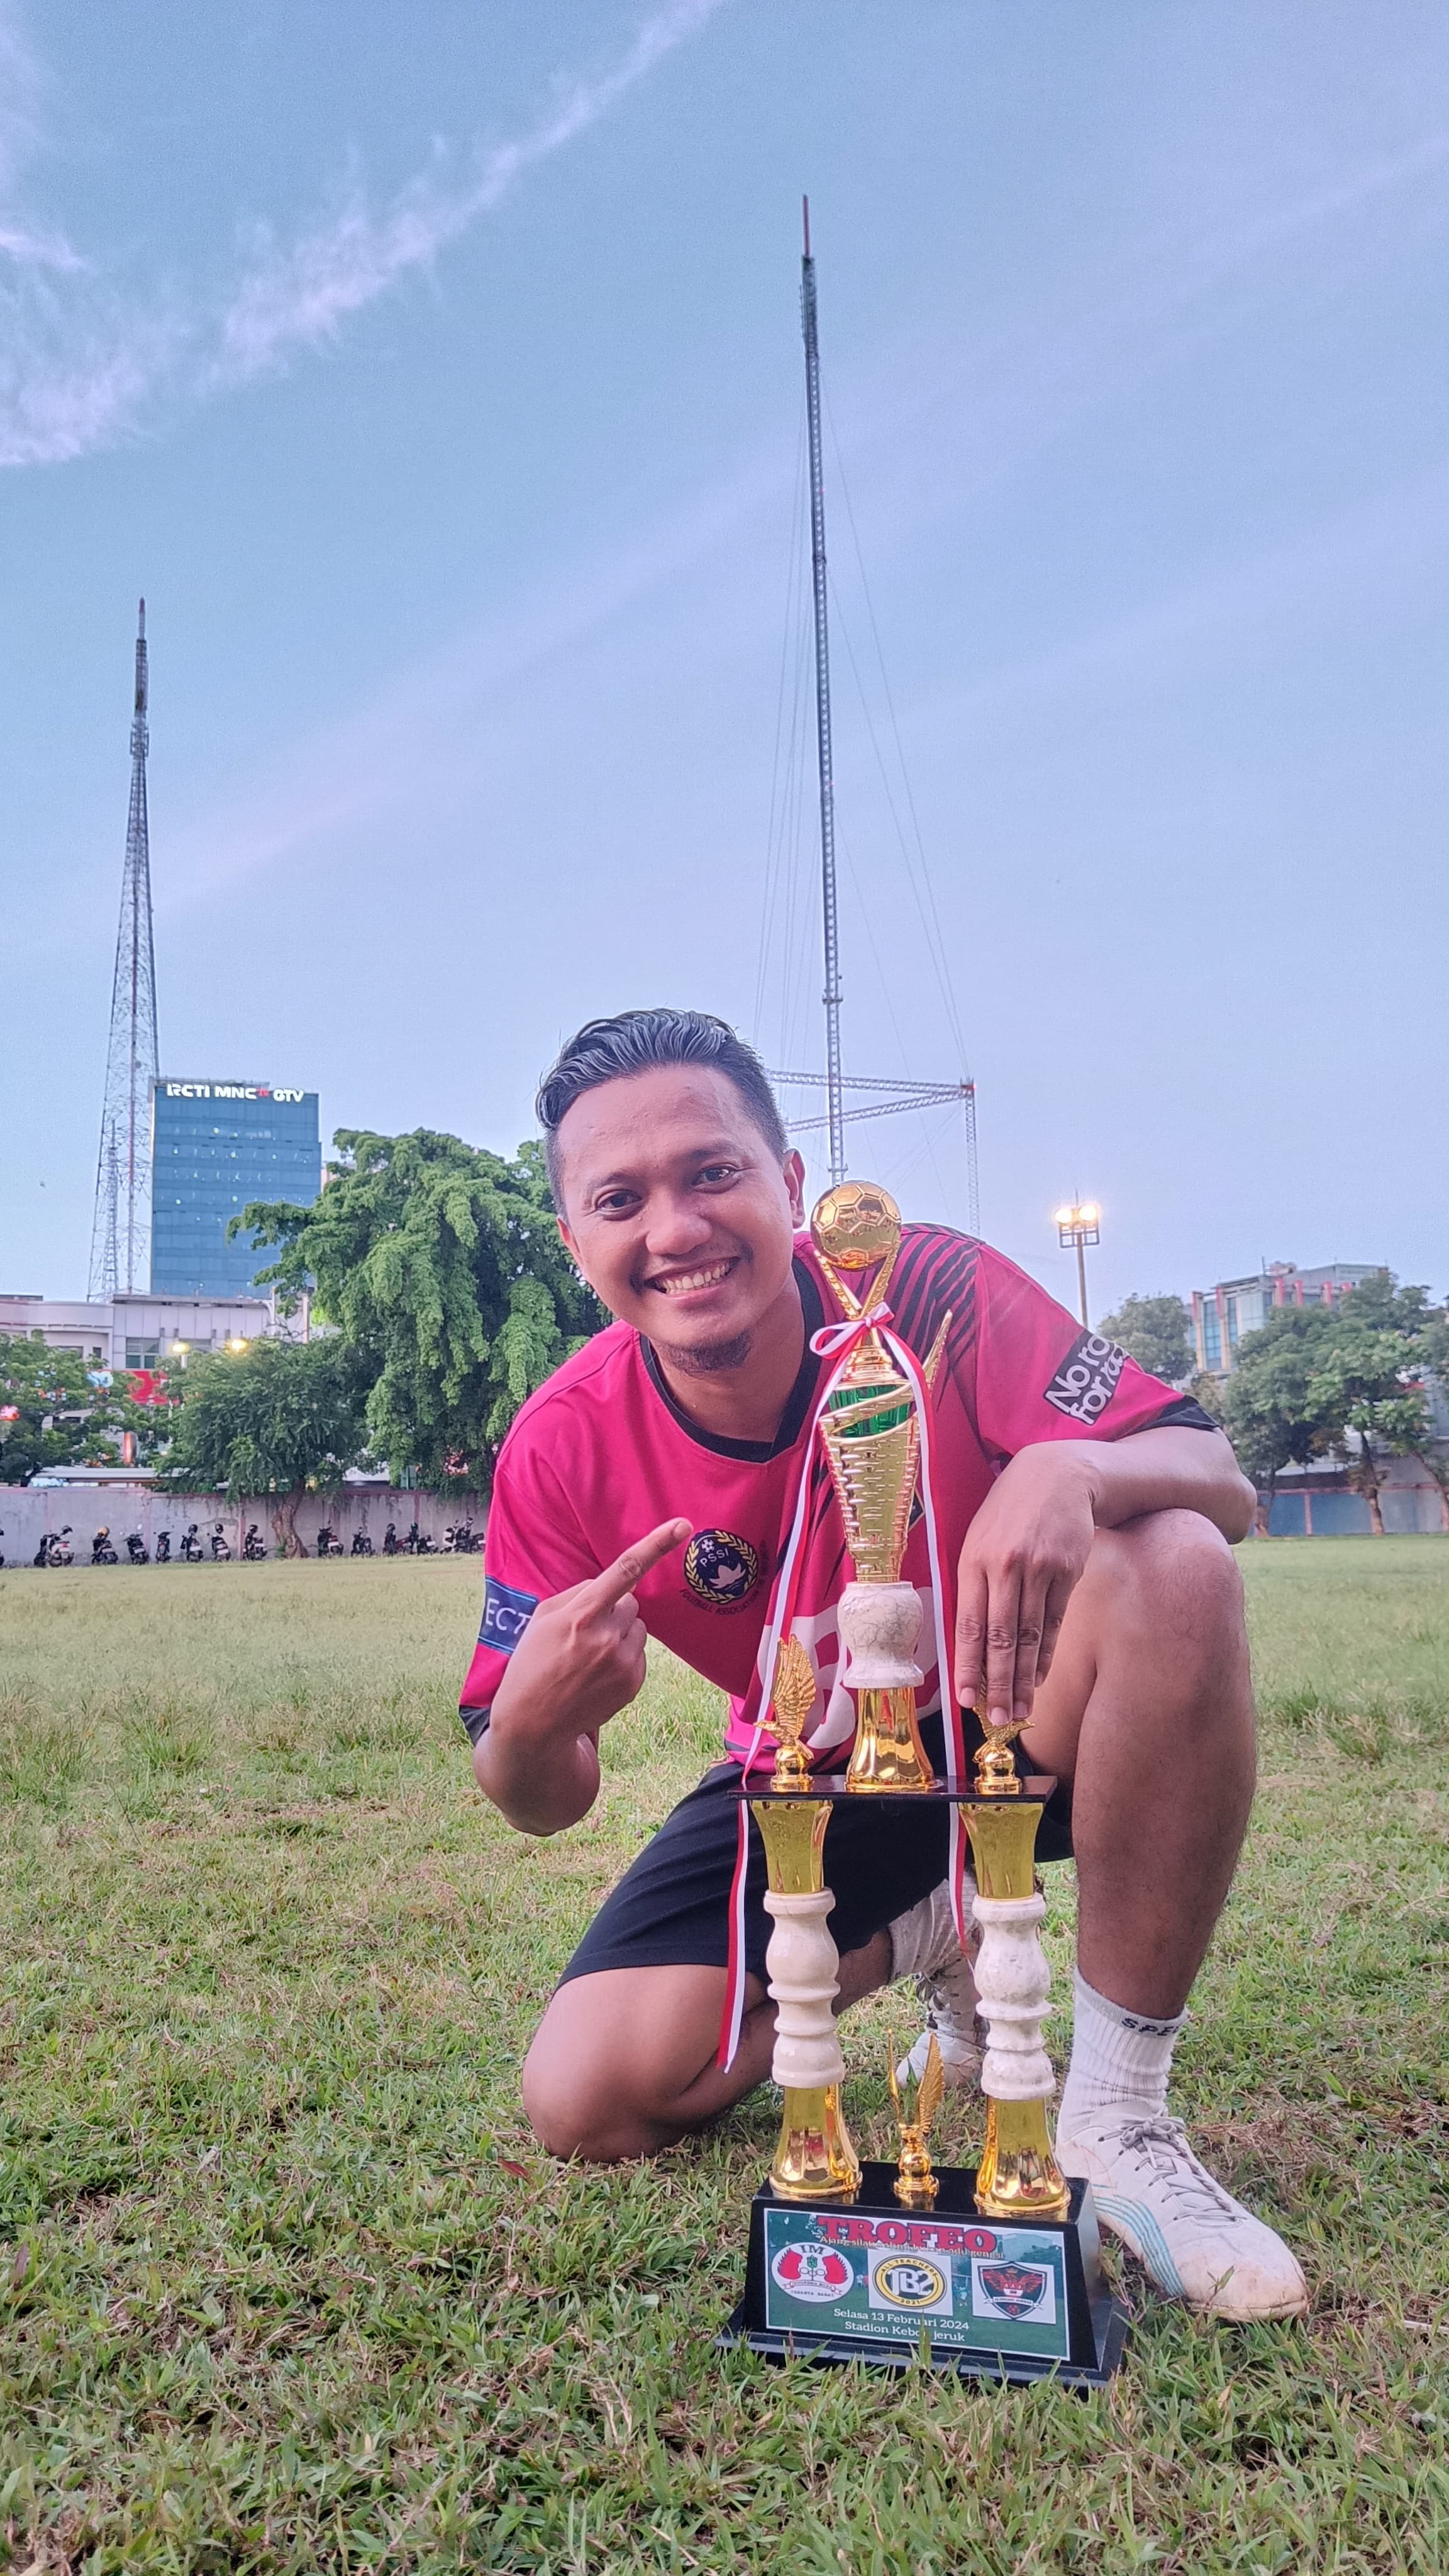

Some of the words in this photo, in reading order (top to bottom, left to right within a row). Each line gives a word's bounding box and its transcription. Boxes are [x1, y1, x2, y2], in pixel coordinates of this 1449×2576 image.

[167, 1084, 210, 1098] RCTI
[273, 1089, 304, 1102] GTV
[1045, 1365, 1091, 1413] No
[1070, 1376, 1112, 1424] for
[700, 1548, 729, 1567] PSSI
[818, 2216, 997, 2253] TROFEO
[799, 2245, 826, 2255] IM
[882, 2262, 894, 2273] ALL
[894, 2258, 938, 2277] TEACHERS
[834, 2308, 869, 2319] Selasa
[872, 2312, 884, 2321] 13
[887, 2314, 937, 2327] Februari
[940, 2319, 969, 2329] 2024
[845, 2321, 889, 2334] Stadion
[934, 2330, 965, 2341] jeruk
